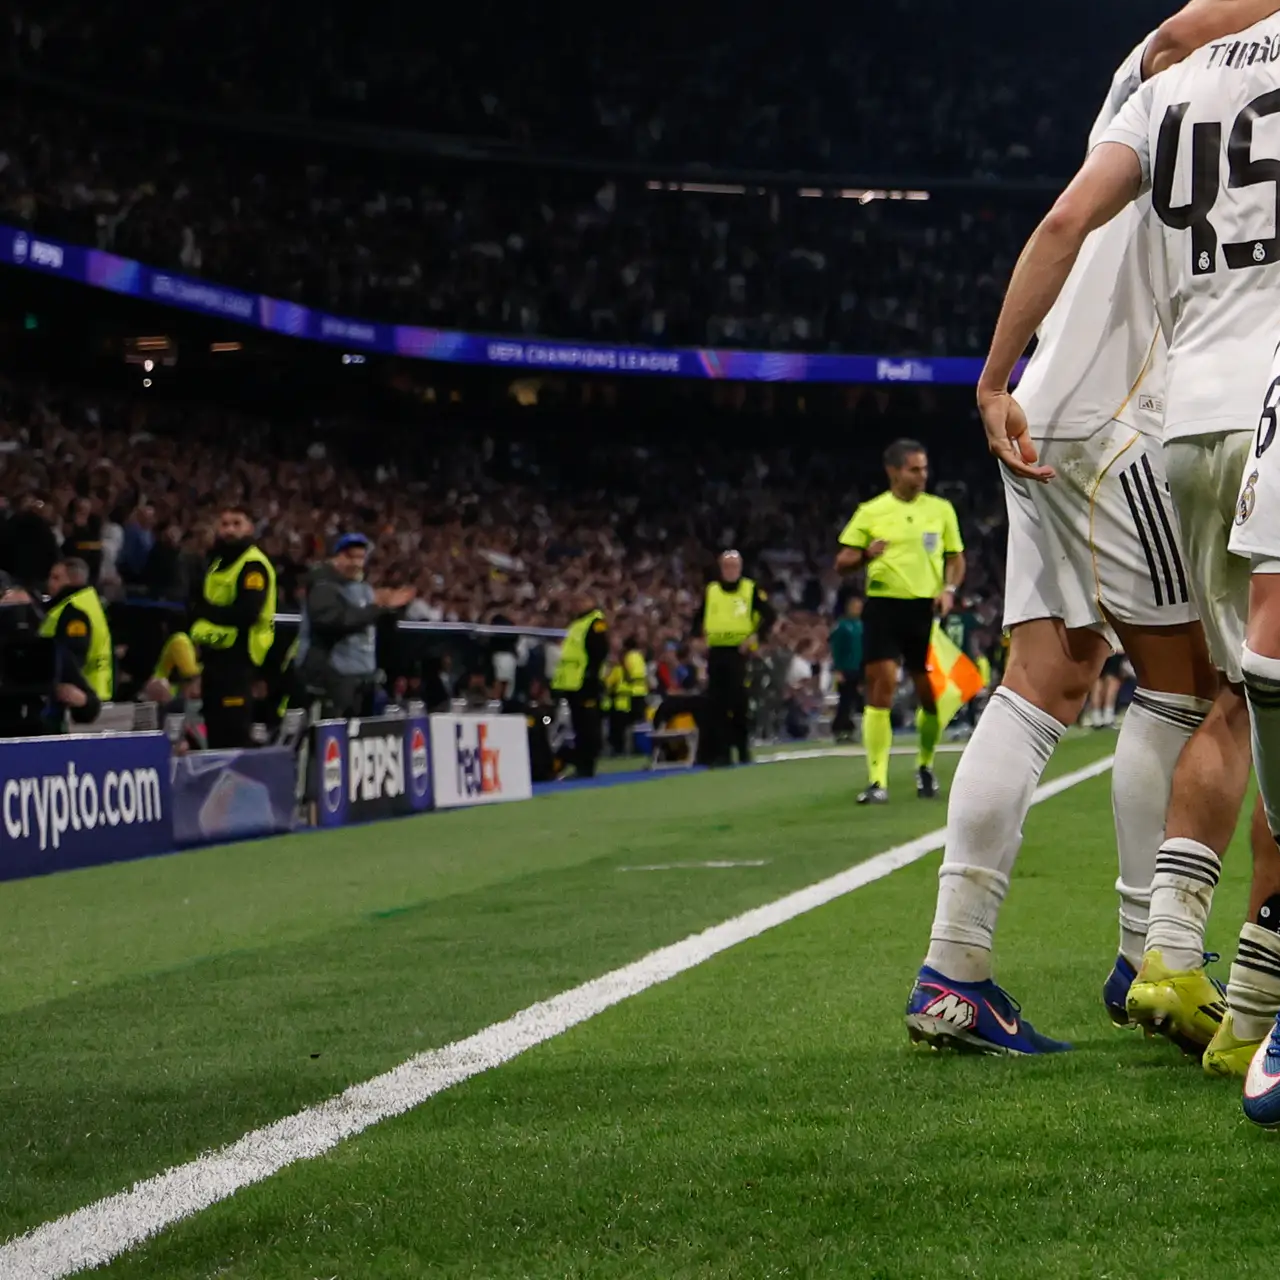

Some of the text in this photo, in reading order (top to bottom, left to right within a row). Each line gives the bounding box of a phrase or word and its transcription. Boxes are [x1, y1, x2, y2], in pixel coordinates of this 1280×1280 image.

[349, 734, 405, 804] PEPSI
[455, 722, 501, 798] FedEx
[3, 761, 162, 851] crypto.com
